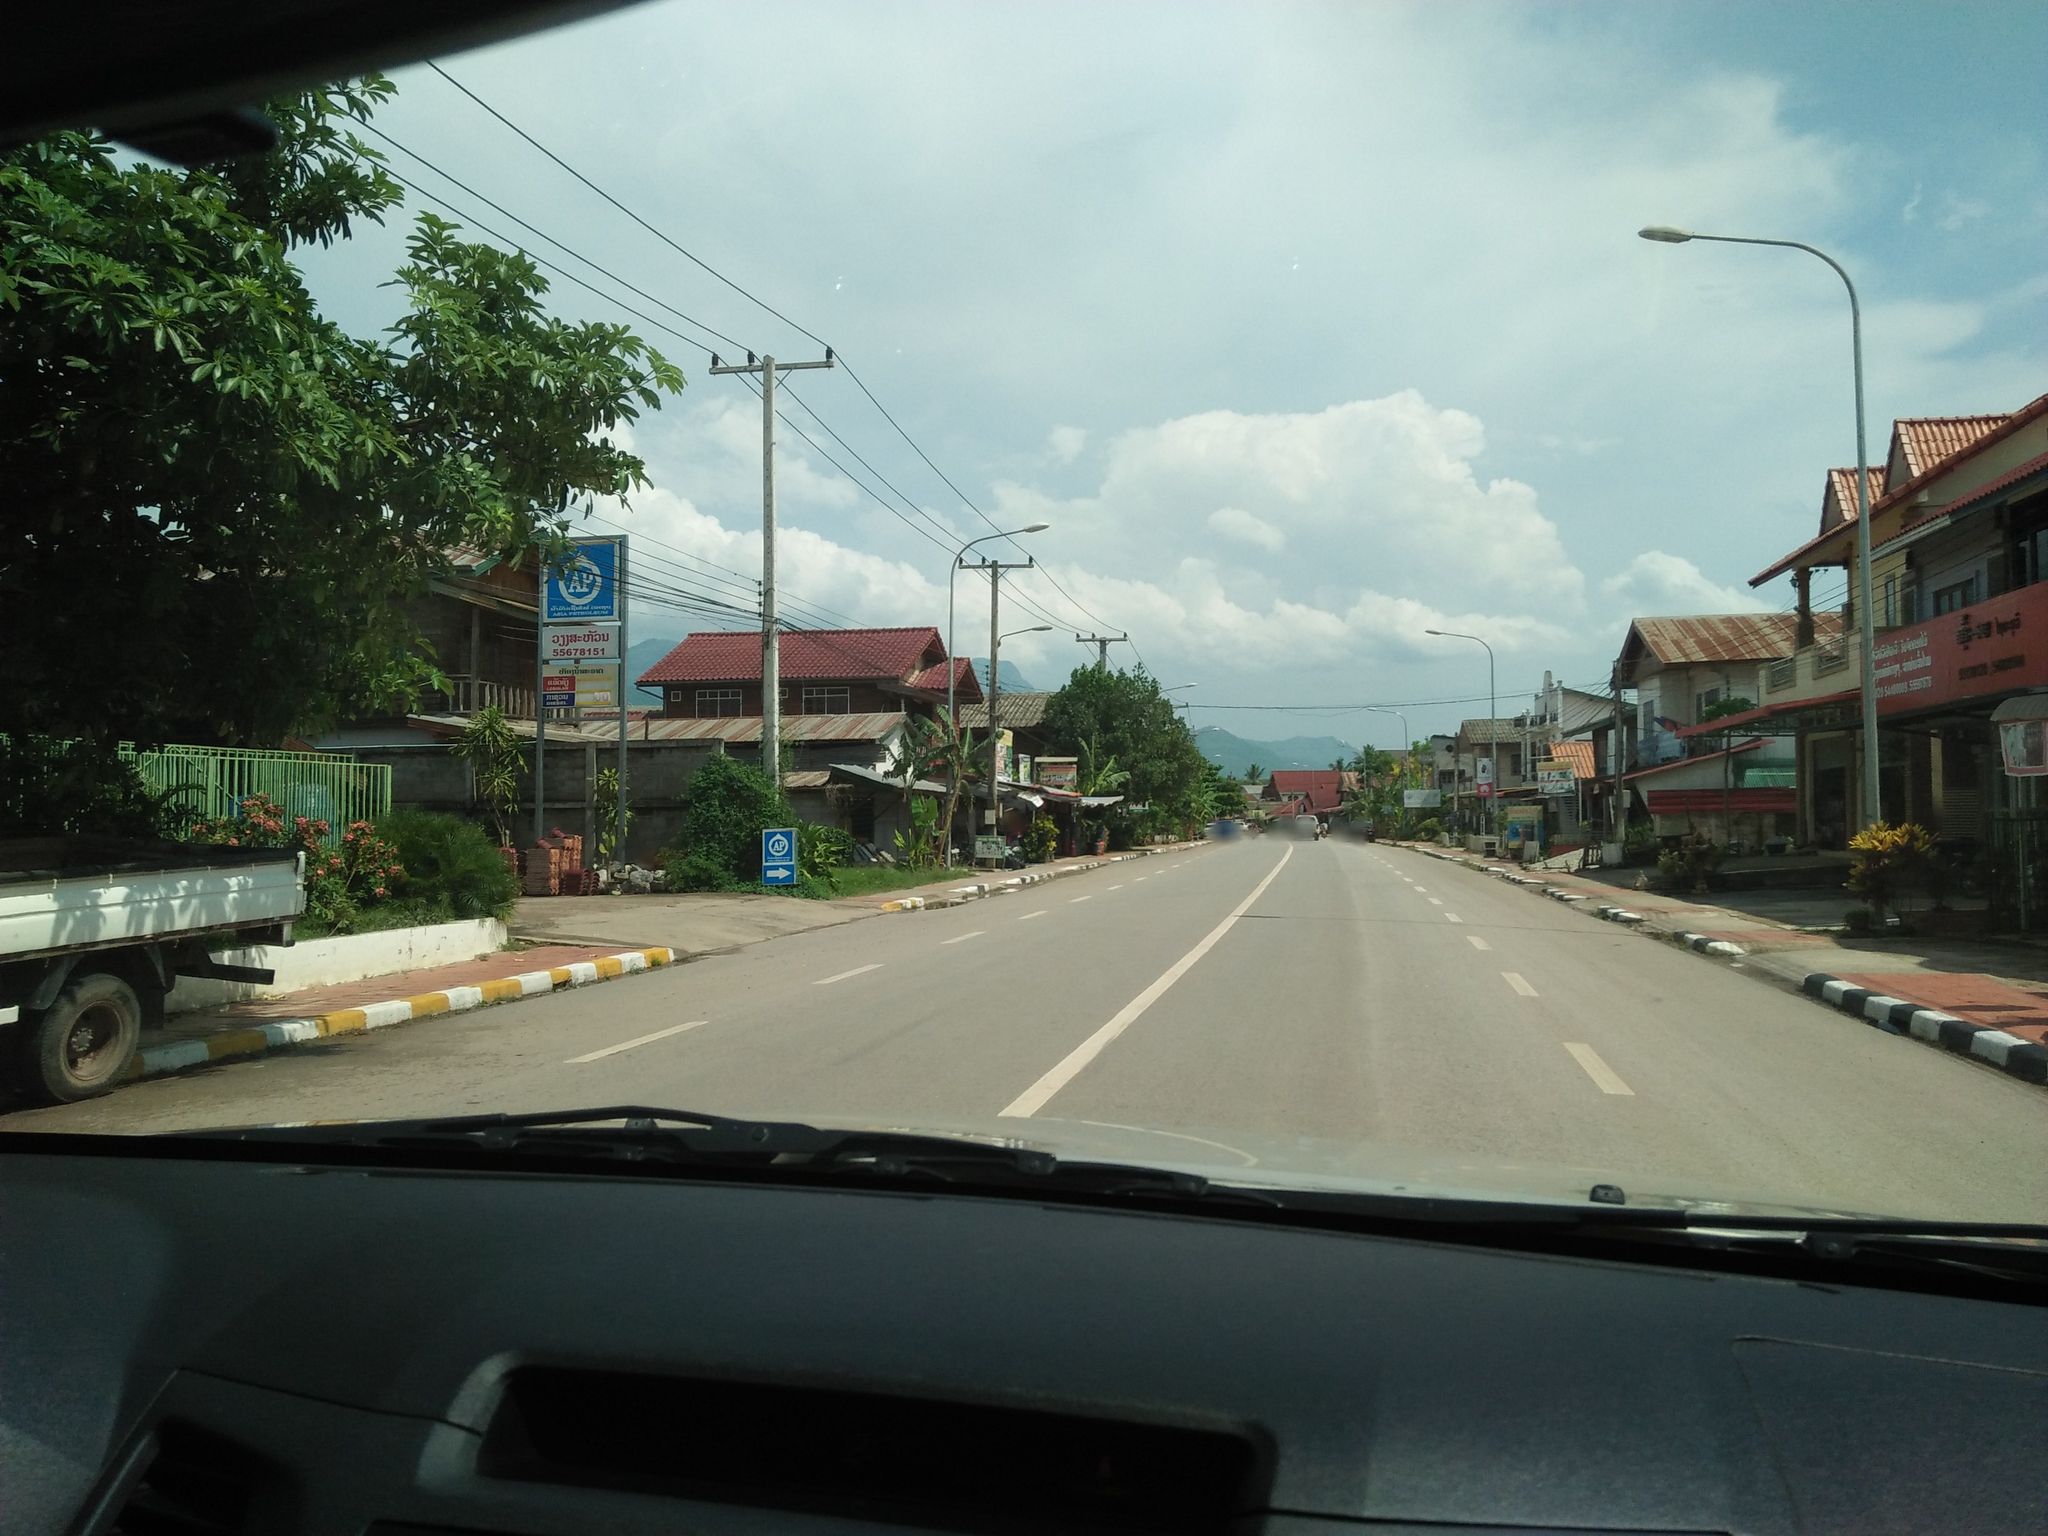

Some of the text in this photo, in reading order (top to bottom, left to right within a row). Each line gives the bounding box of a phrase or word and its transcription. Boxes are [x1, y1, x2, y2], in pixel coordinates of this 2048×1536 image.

[568, 571, 593, 594] AP
[552, 647, 605, 657] 55678151
[773, 841, 785, 851] AP
